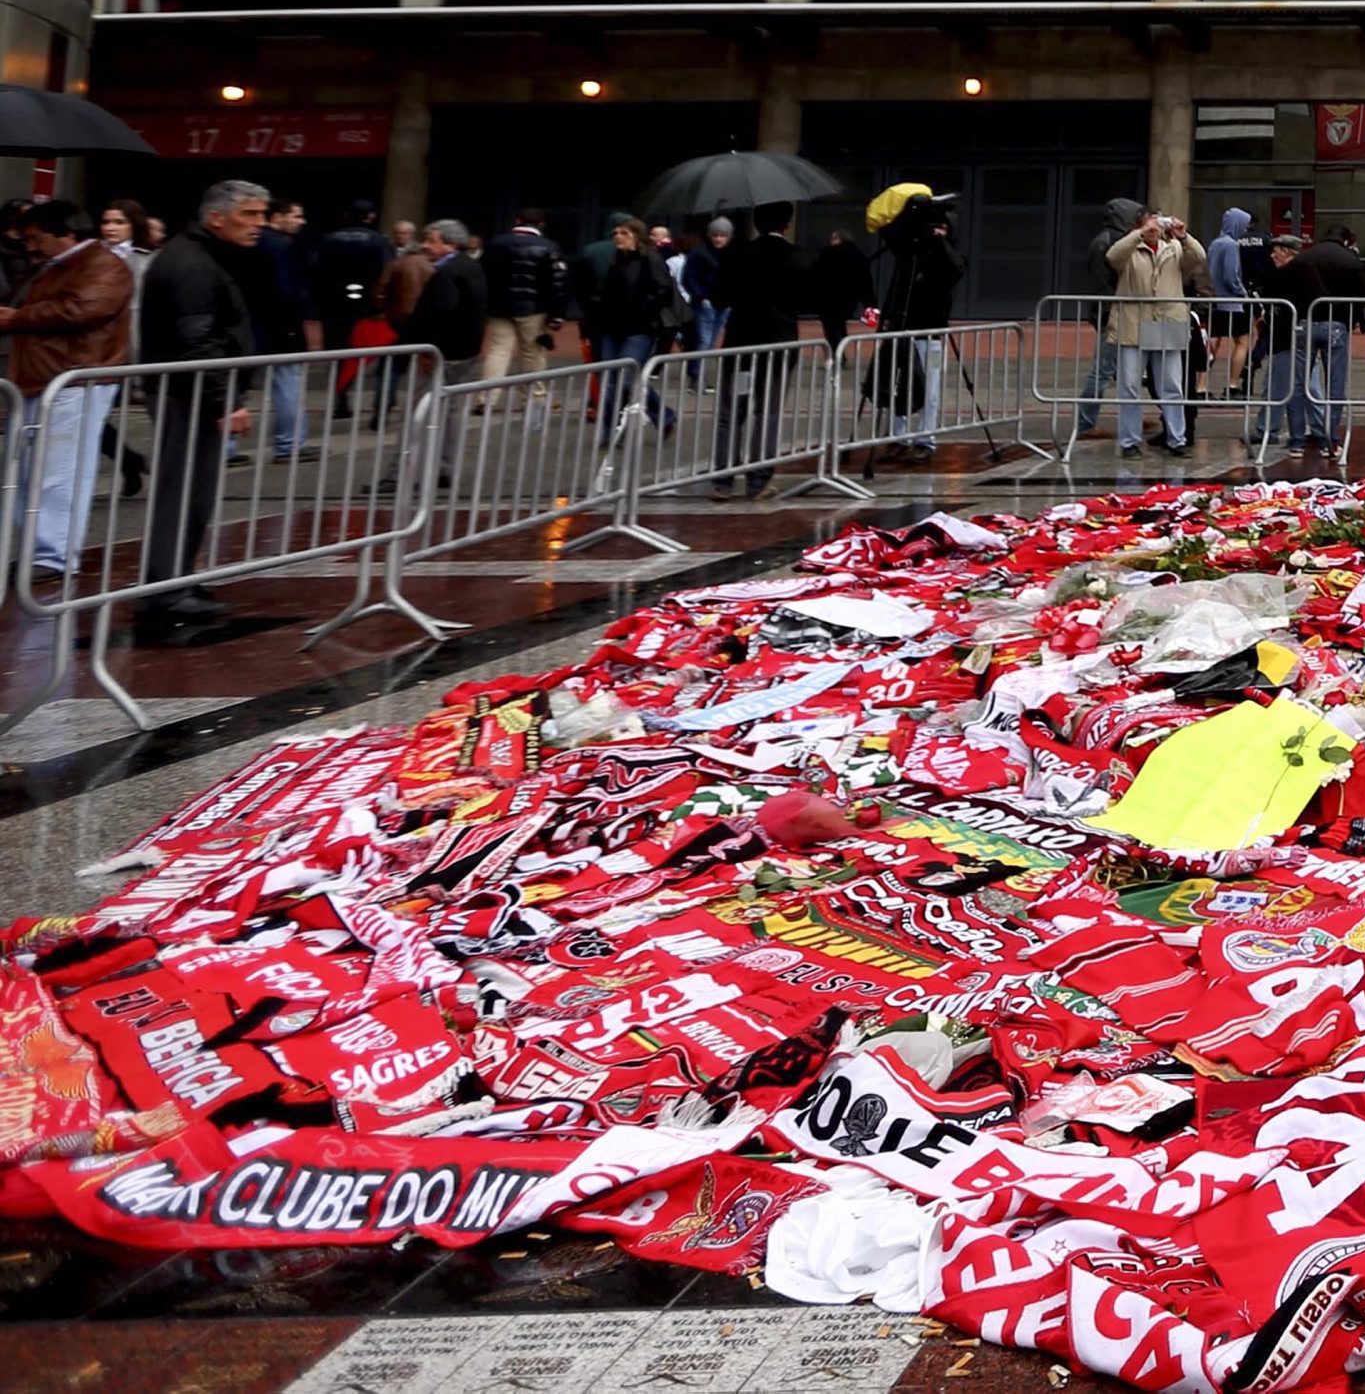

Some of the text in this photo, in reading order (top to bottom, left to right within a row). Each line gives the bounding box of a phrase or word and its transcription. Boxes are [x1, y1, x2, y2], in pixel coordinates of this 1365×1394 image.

[866, 680, 915, 703] 30
[330, 1040, 452, 1092] SAGRES
[218, 1162, 388, 1231] CLUBE
[376, 1168, 456, 1230] DO
